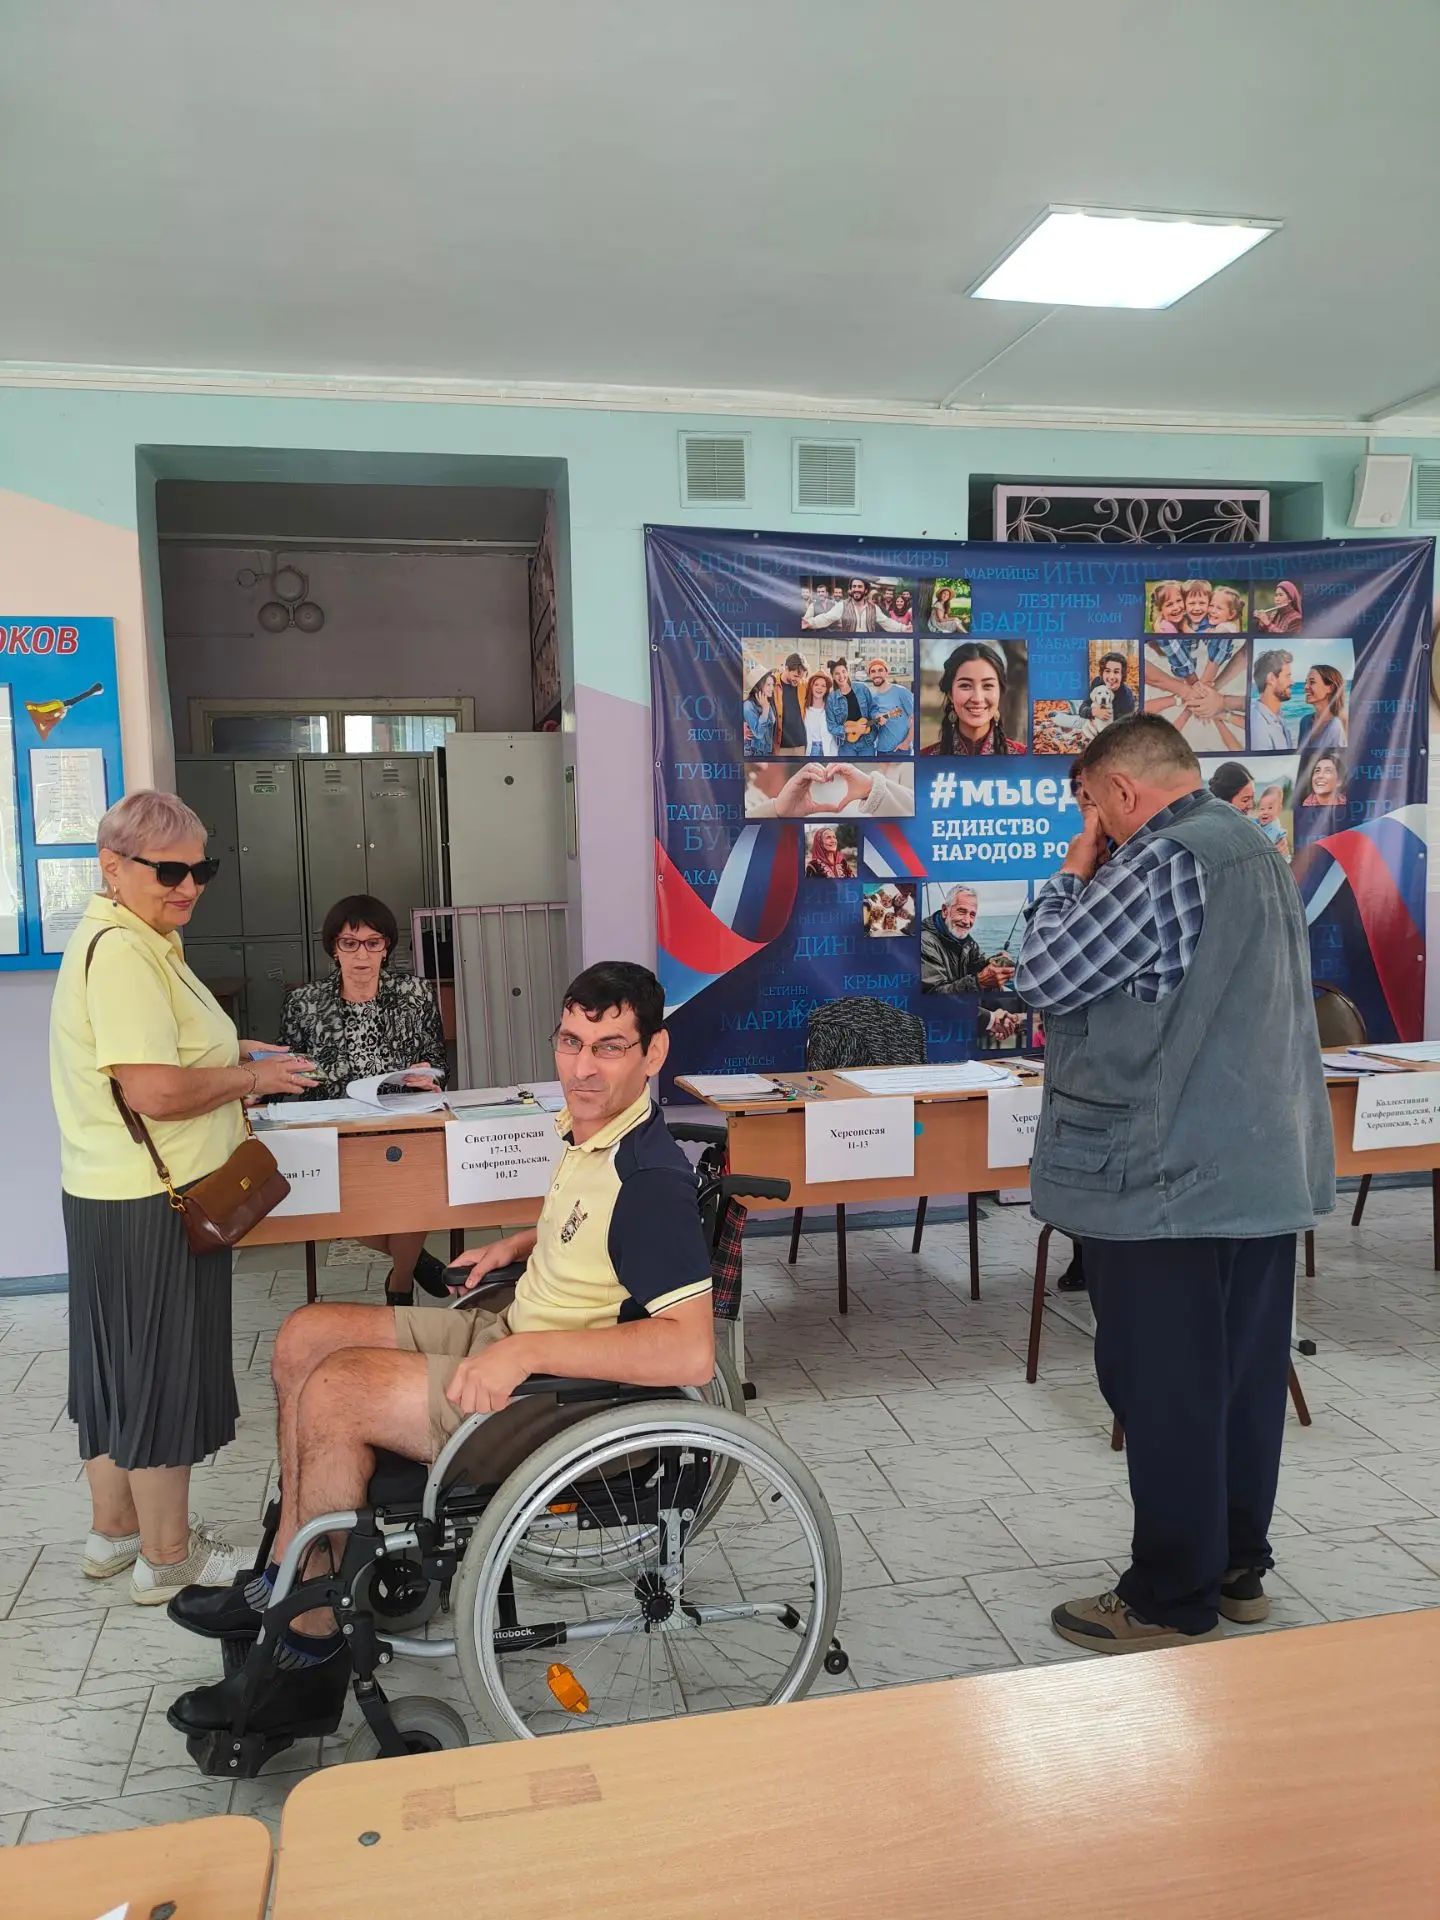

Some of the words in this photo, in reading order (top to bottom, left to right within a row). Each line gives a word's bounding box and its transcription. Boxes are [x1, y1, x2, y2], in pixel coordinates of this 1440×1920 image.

[963, 565, 1040, 581] МАРИЙЦЫ
[1016, 593, 1101, 608] ЛЕЗГИНЫ
[687, 727, 737, 742] ЯКУТЫ
[931, 817, 1051, 841] ЕДИНСТВО
[931, 841, 1038, 864] НАРОДОВ
[1375, 1097, 1429, 1107] Коллективная
[464, 1130, 545, 1144] Светлогорская
[830, 1127, 886, 1140] Херсонская
[847, 1140, 869, 1149] 11-13
[301, 1169, 321, 1179] 1-17
